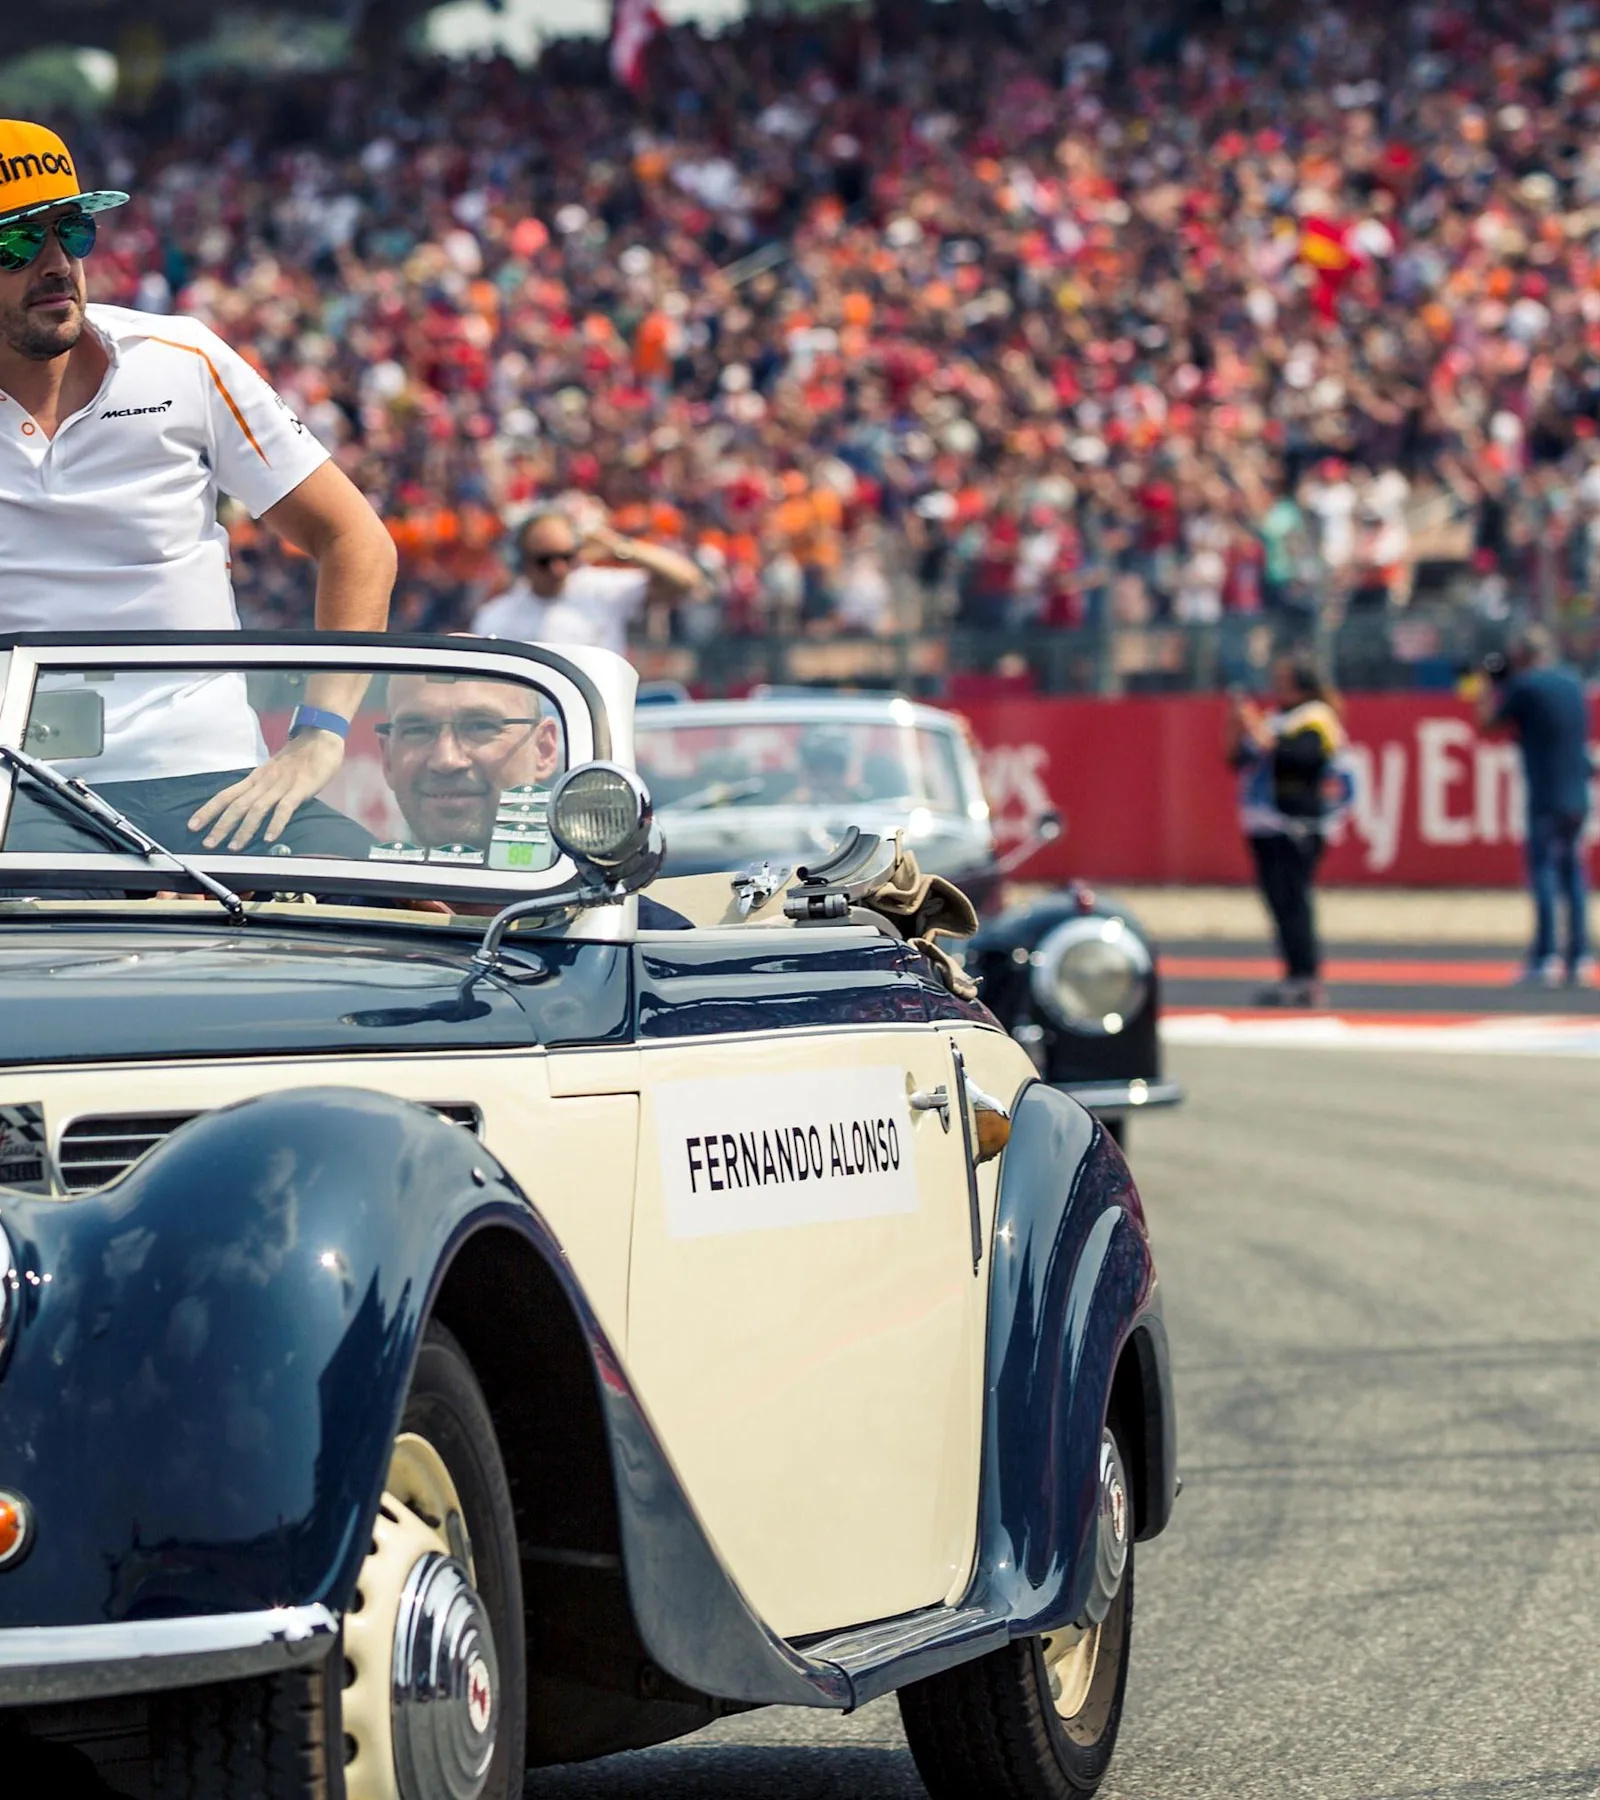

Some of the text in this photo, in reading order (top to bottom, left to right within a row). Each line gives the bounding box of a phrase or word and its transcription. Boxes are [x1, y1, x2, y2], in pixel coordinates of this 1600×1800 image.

[101, 404, 168, 419] McLaren
[686, 1117, 900, 1193] FERNANDO ALONSO
